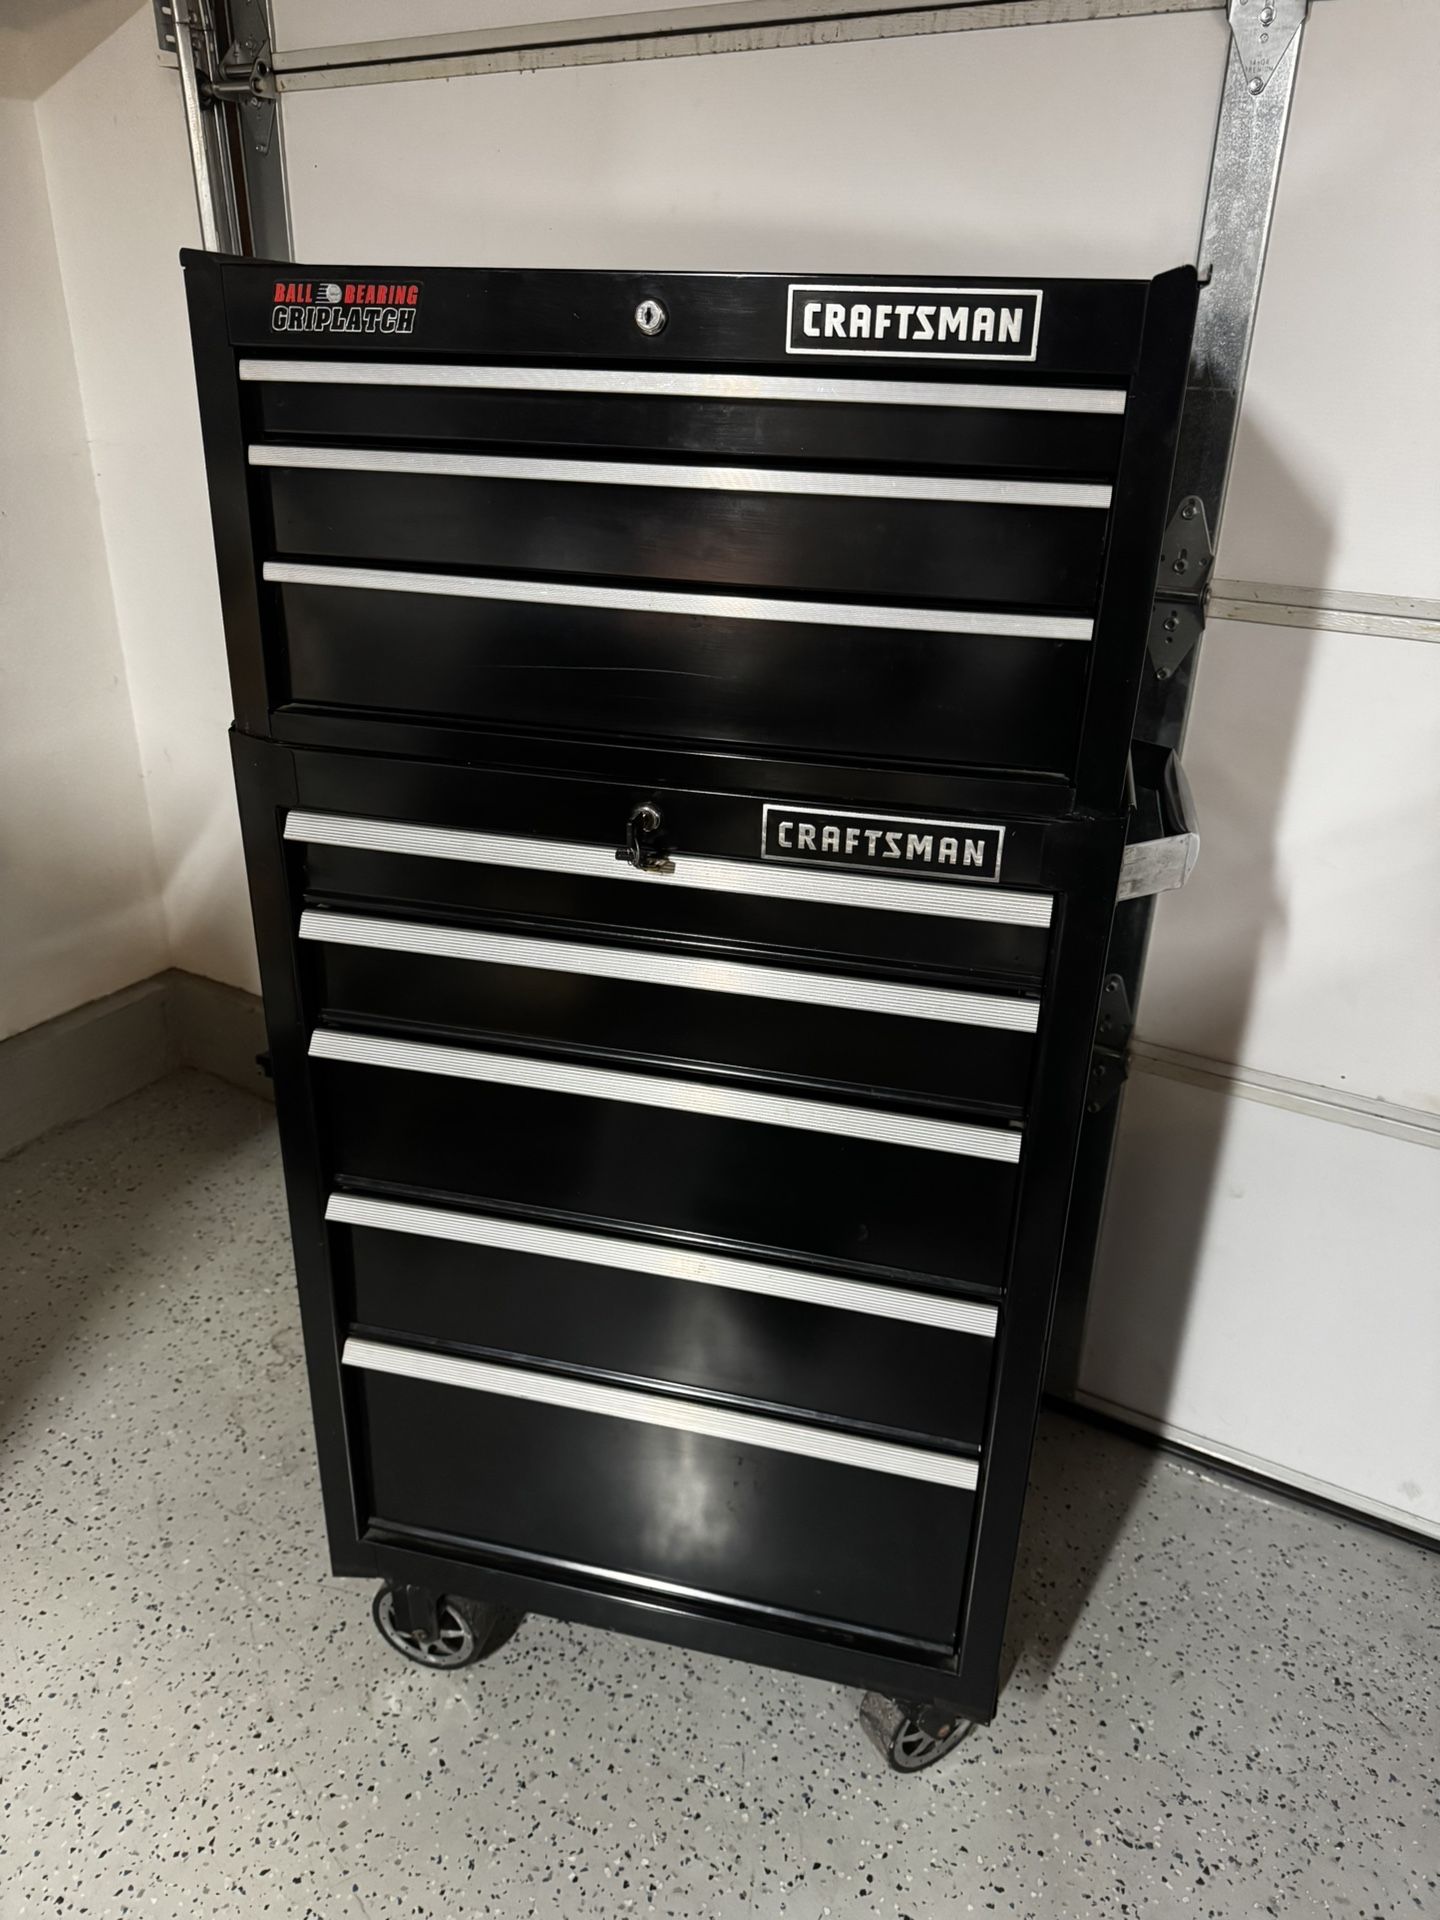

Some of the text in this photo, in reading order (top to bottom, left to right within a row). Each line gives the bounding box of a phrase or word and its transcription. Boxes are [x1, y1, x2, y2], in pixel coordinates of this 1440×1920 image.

[274, 283, 419, 305] BALL BEARING
[272, 305, 416, 333] GRIPLATCH
[803, 303, 1023, 342] CRAFTSMAN
[778, 821, 984, 867] CRAFTSMAN
